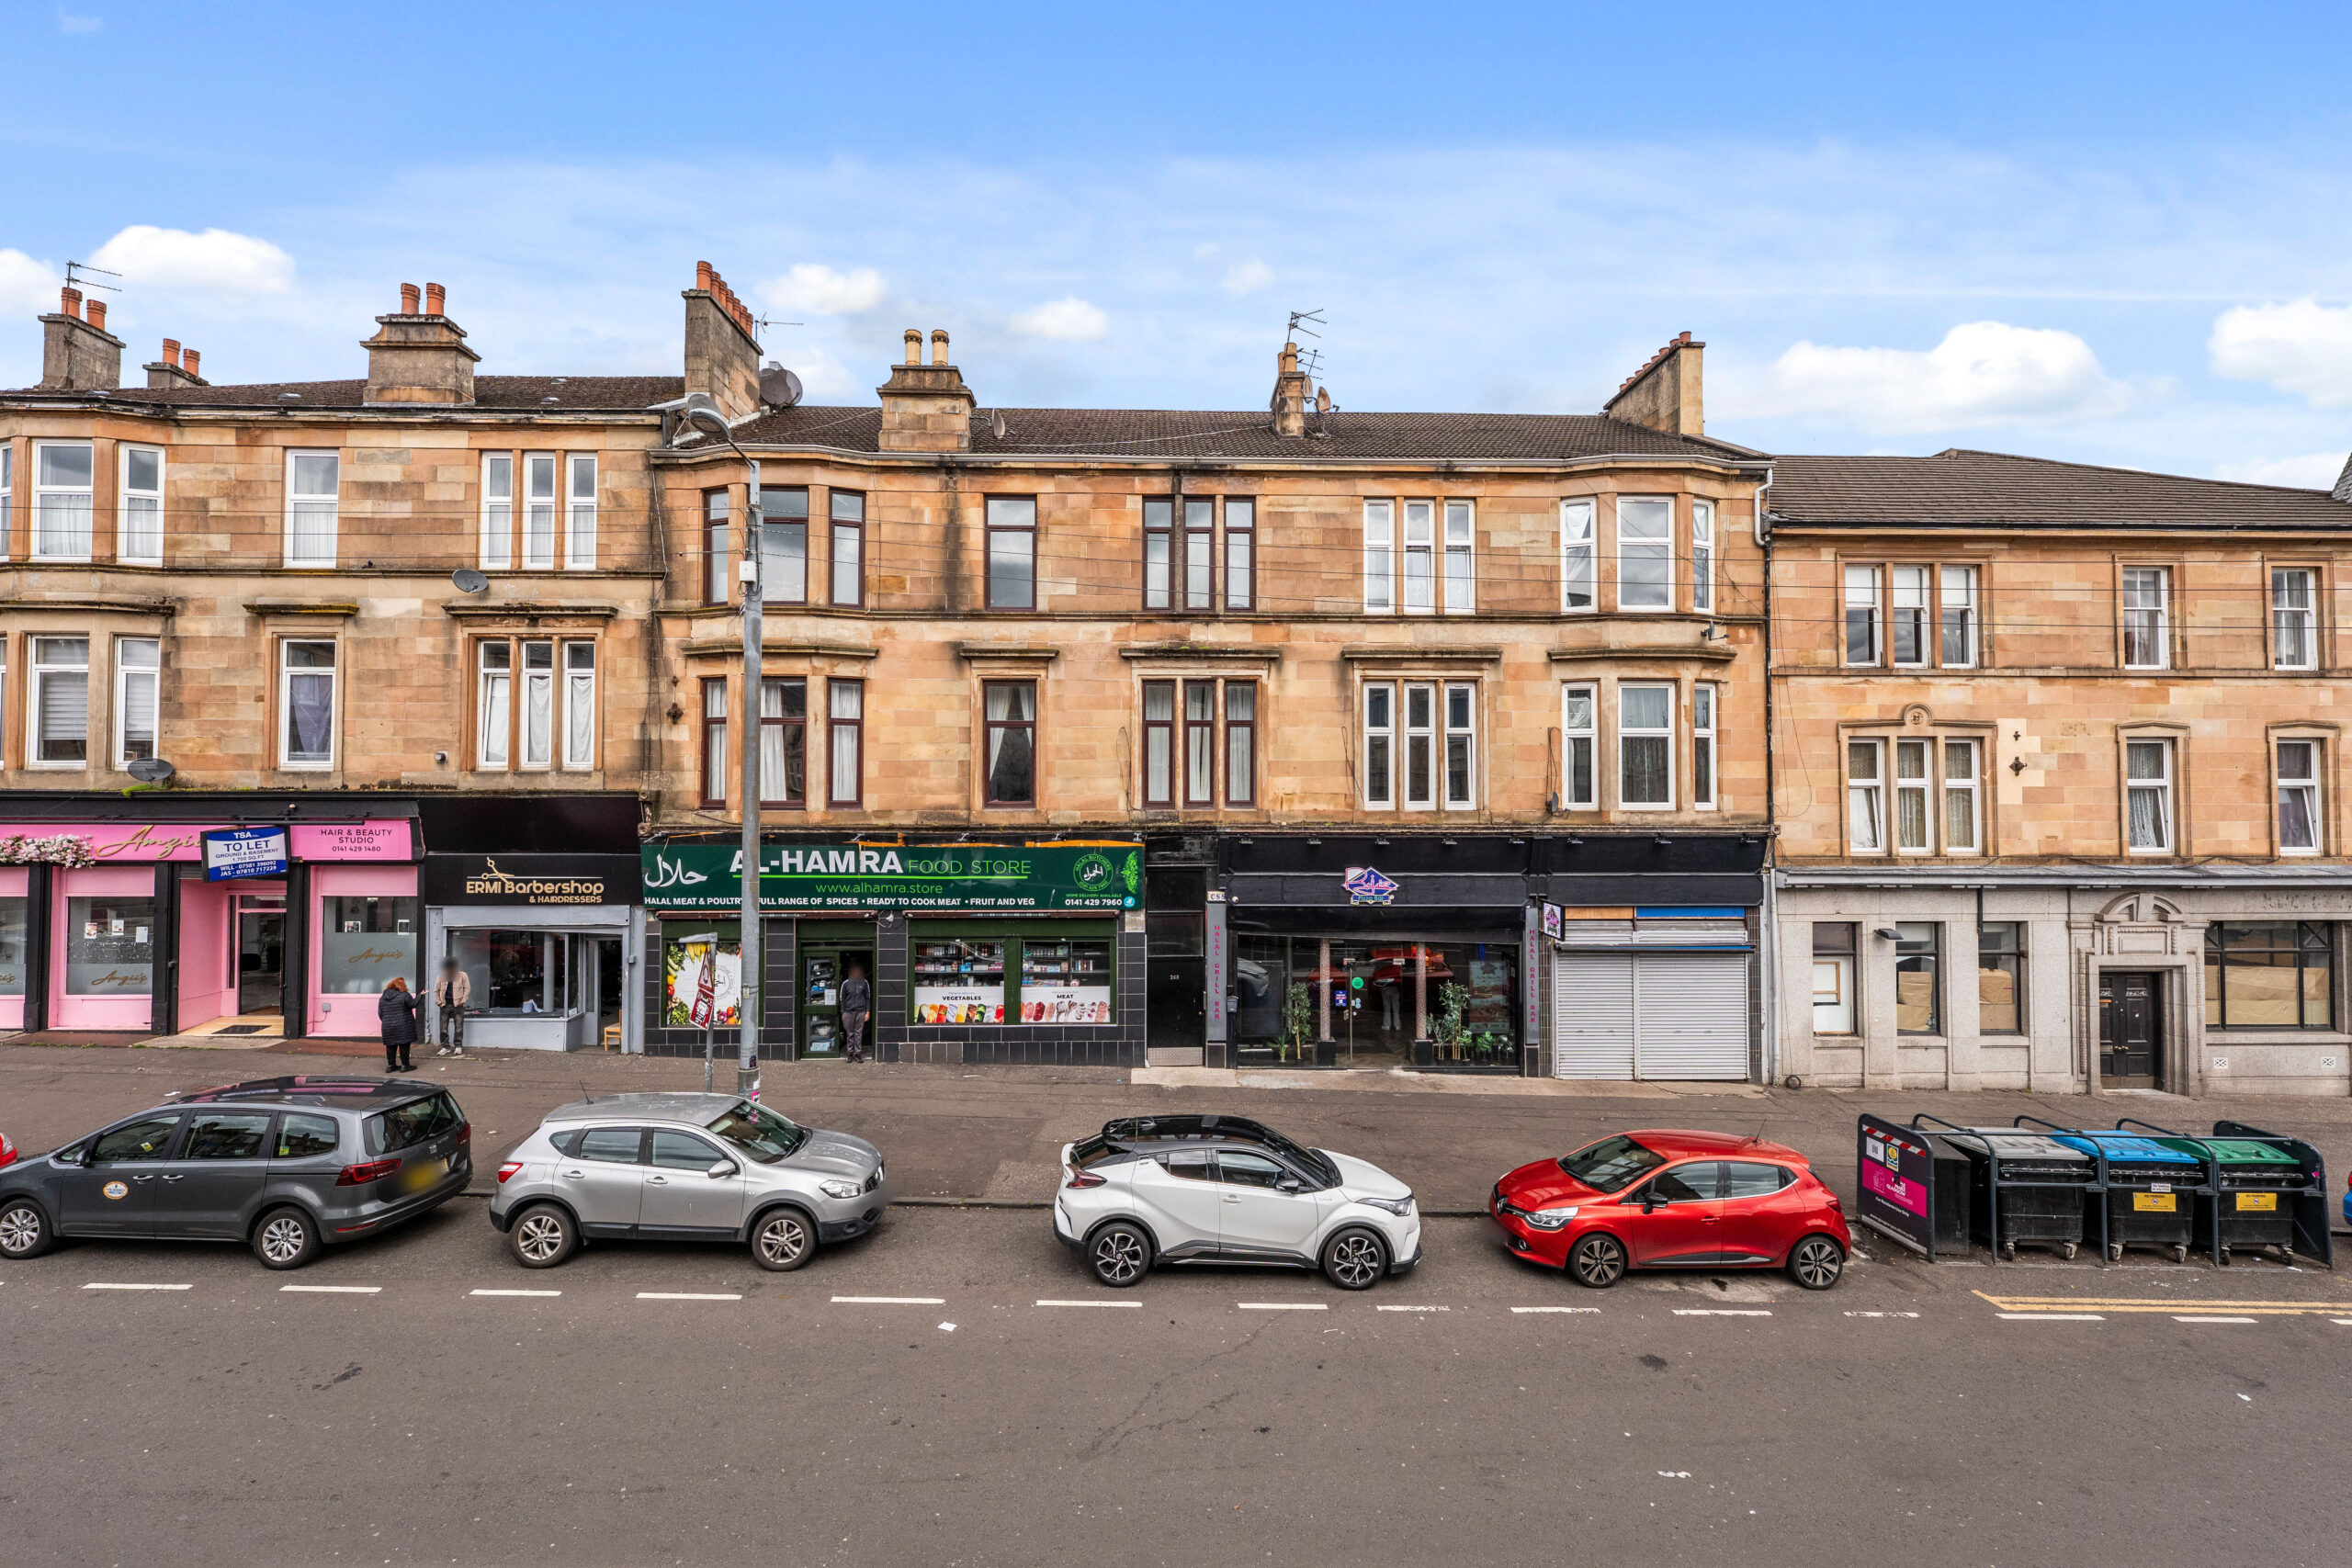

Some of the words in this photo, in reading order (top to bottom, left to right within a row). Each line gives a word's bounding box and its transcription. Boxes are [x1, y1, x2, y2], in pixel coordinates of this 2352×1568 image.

[224, 842, 243, 852] TO
[247, 840, 270, 850] LET
[644, 853, 708, 887] حلال
[908, 860, 963, 874] FOOD
[971, 860, 1032, 874] STORE
[466, 881, 502, 894] ERMI
[504, 880, 605, 896] Barbershop
[815, 882, 944, 894] www.alhamra.store
